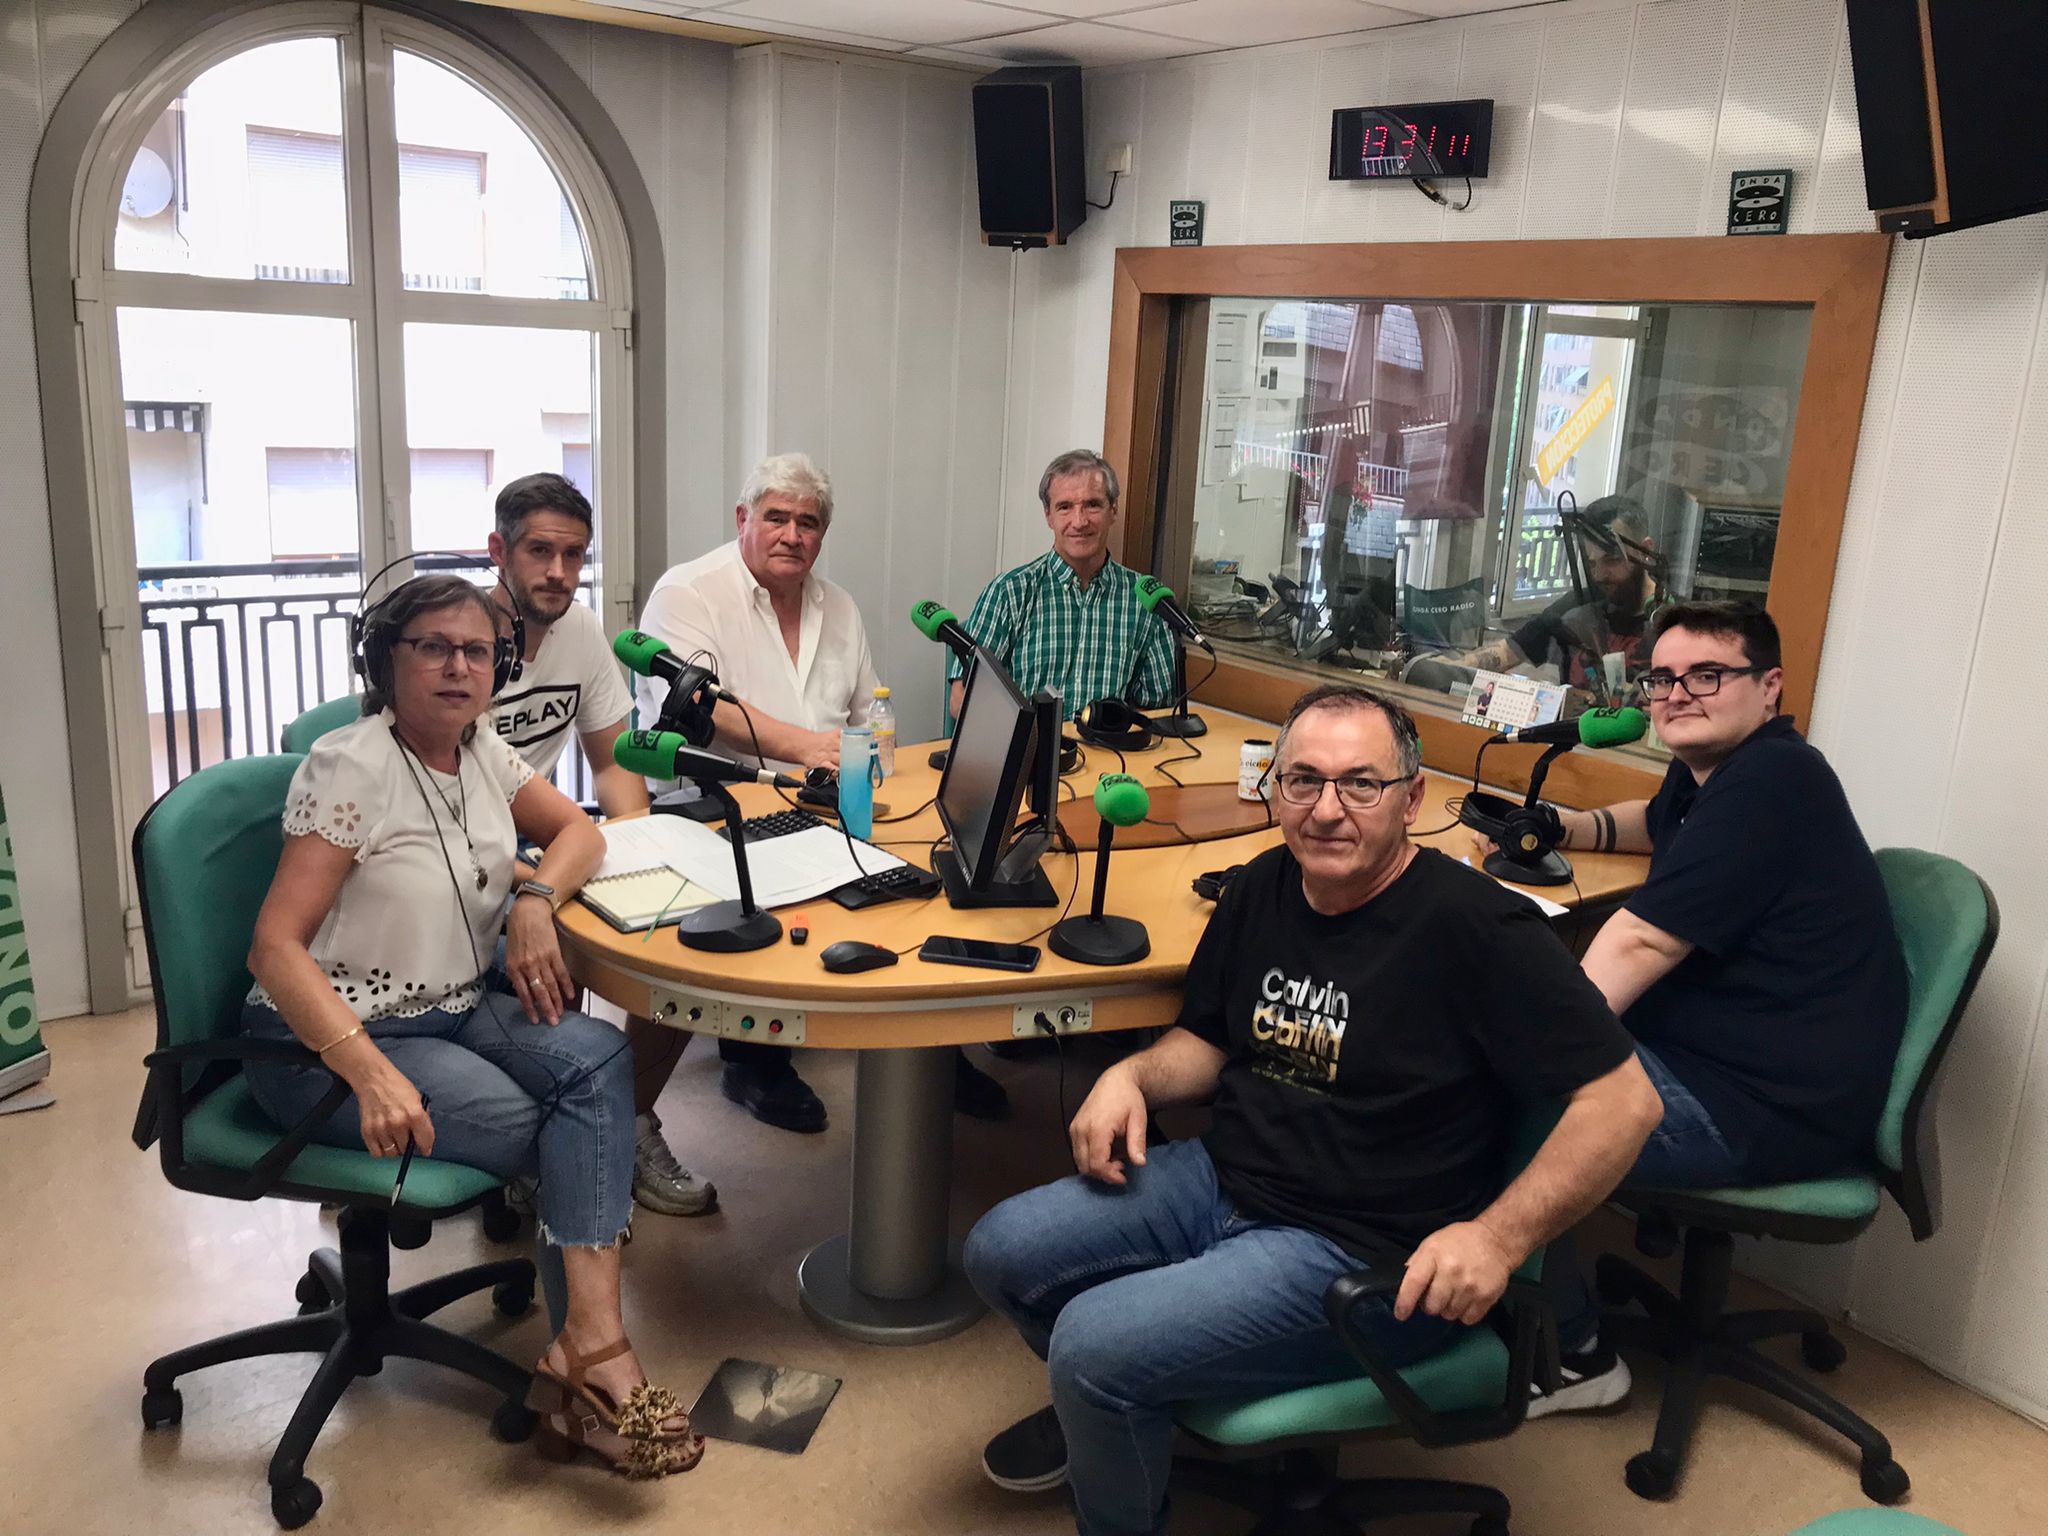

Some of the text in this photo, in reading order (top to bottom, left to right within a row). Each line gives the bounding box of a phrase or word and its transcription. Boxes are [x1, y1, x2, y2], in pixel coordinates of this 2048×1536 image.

[1740, 177, 1780, 187] ONDA
[1734, 210, 1776, 222] CERO
[1173, 229, 1197, 238] CERO
[1450, 601, 1475, 612] RADIO
[496, 695, 573, 736] EPLAY
[1261, 966, 1350, 1019] Calvin
